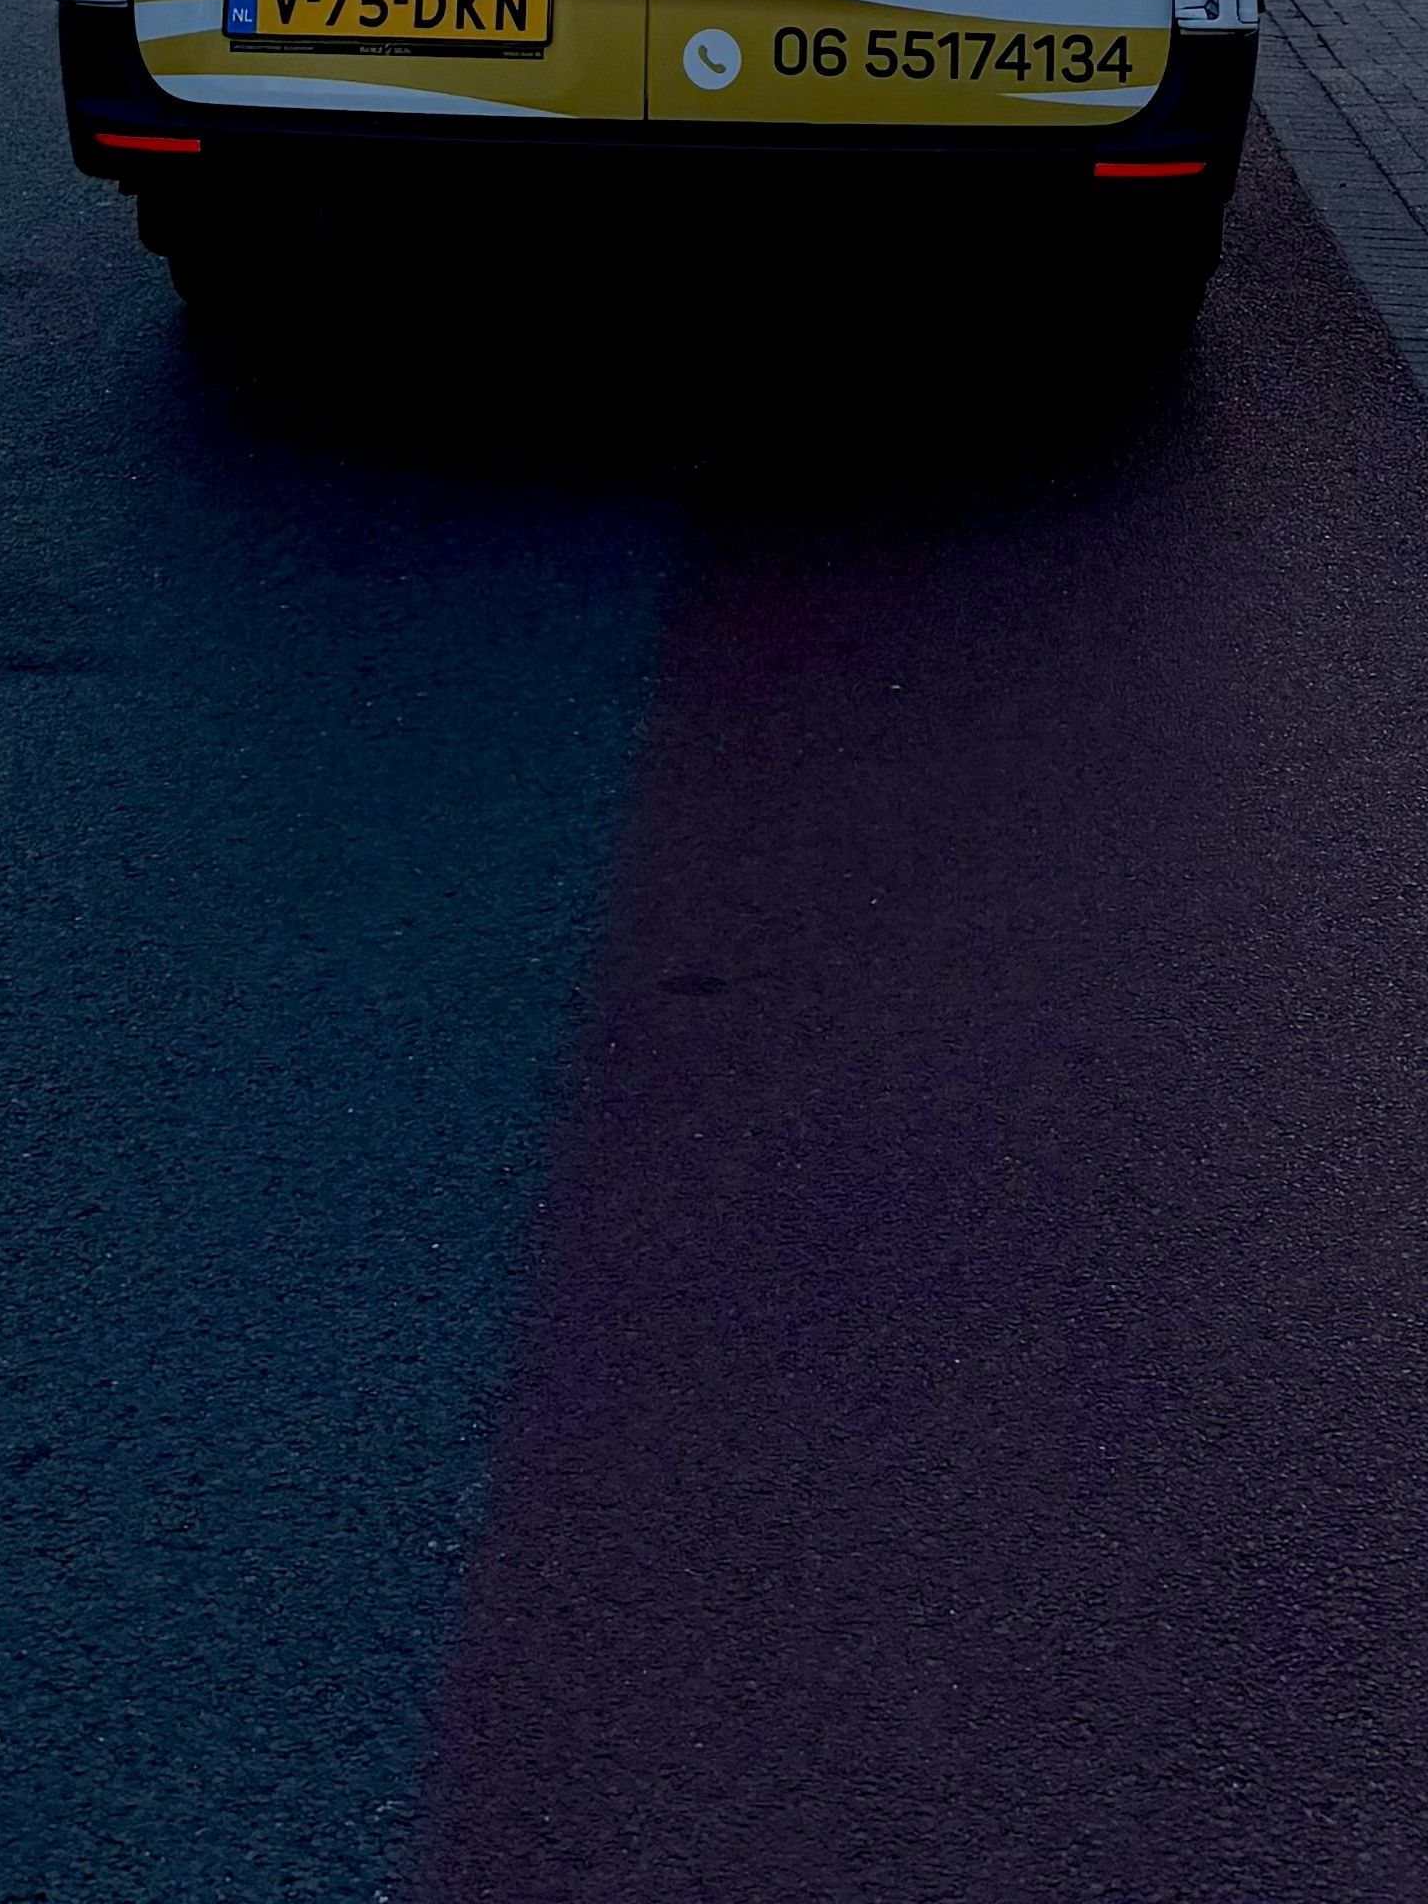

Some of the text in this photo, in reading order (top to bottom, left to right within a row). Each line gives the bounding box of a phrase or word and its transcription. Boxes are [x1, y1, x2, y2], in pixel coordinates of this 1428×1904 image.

[232, 7, 253, 24] NL
[773, 25, 1134, 84] 06 55174134
